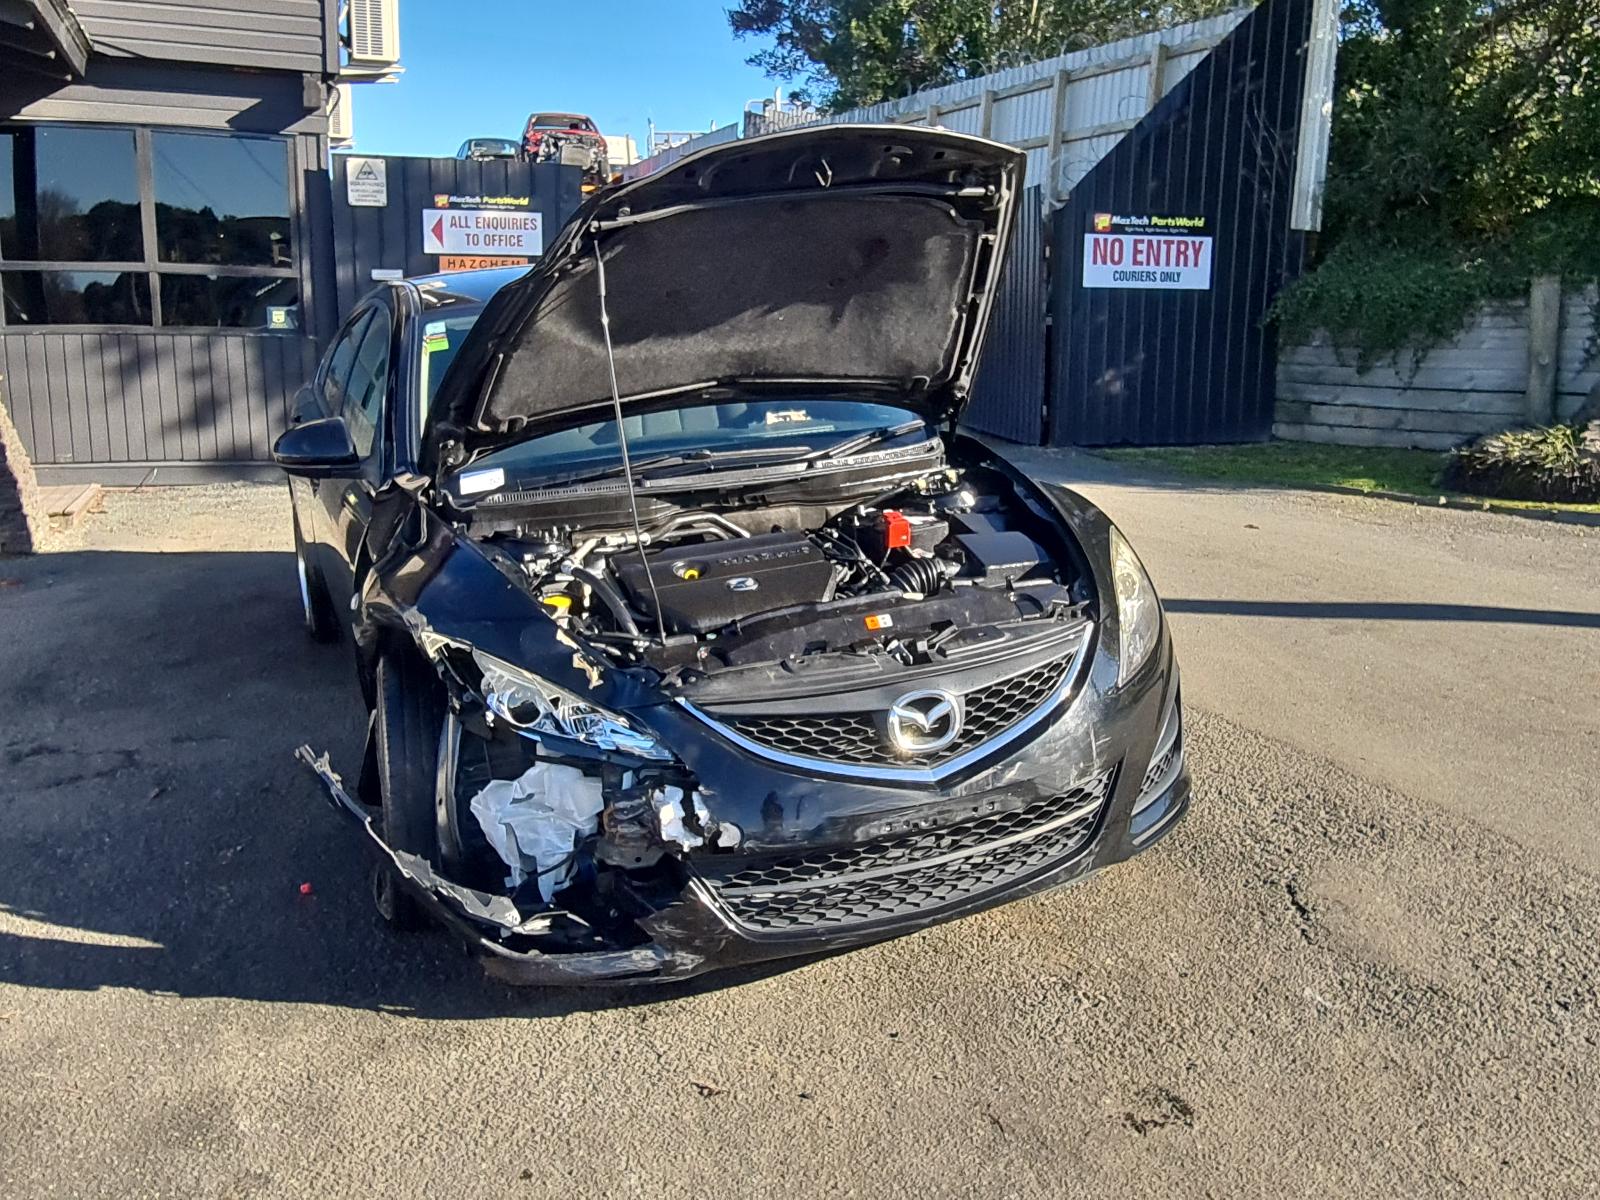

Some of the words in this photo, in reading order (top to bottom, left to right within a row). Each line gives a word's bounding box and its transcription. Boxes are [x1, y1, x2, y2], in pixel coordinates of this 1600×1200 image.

[483, 195, 529, 206] PartsWorld
[450, 215, 471, 228] ALL
[475, 216, 538, 231] ENQUIRIES
[1111, 215, 1149, 225] MaxTech
[1151, 216, 1205, 227] PartsWorld
[465, 233, 479, 246] TO
[483, 234, 524, 247] OFFICE
[1092, 237, 1124, 266] NO
[1132, 238, 1204, 268] ENTRY
[1112, 270, 1157, 282] COURIERS
[1160, 271, 1181, 283] ONLY
